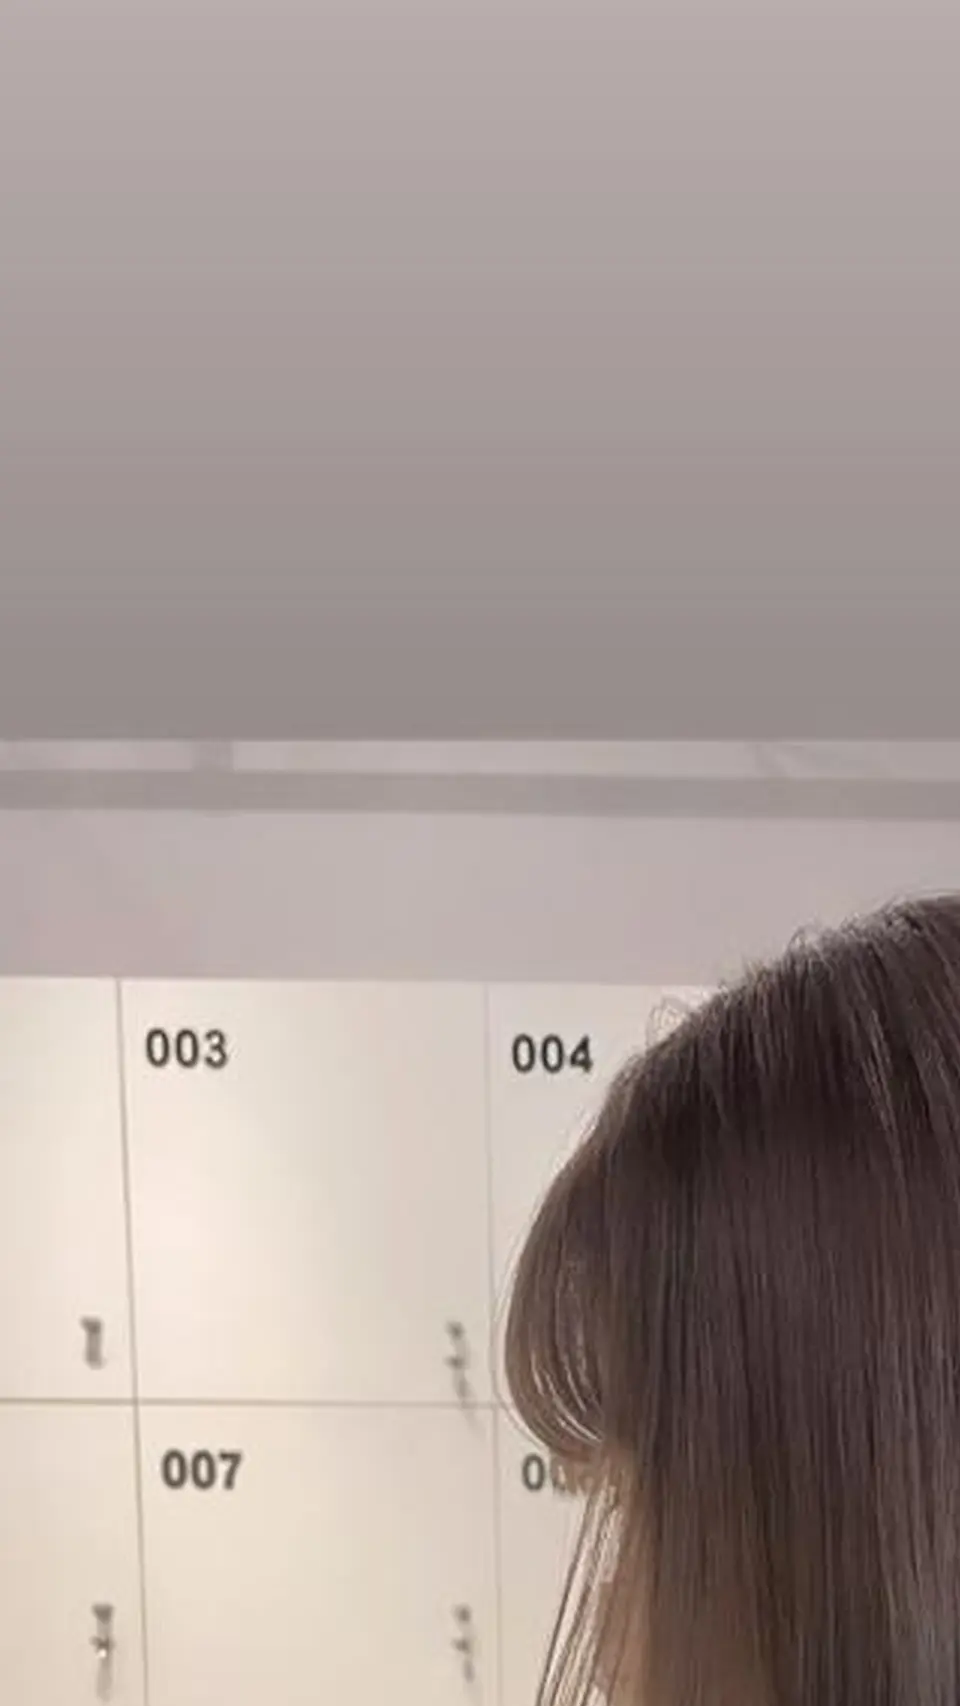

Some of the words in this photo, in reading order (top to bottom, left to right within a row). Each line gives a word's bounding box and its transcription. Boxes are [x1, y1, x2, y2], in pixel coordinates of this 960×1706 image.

[145, 1027, 229, 1070] 003
[511, 1033, 594, 1075] 004
[161, 1449, 243, 1491] 007
